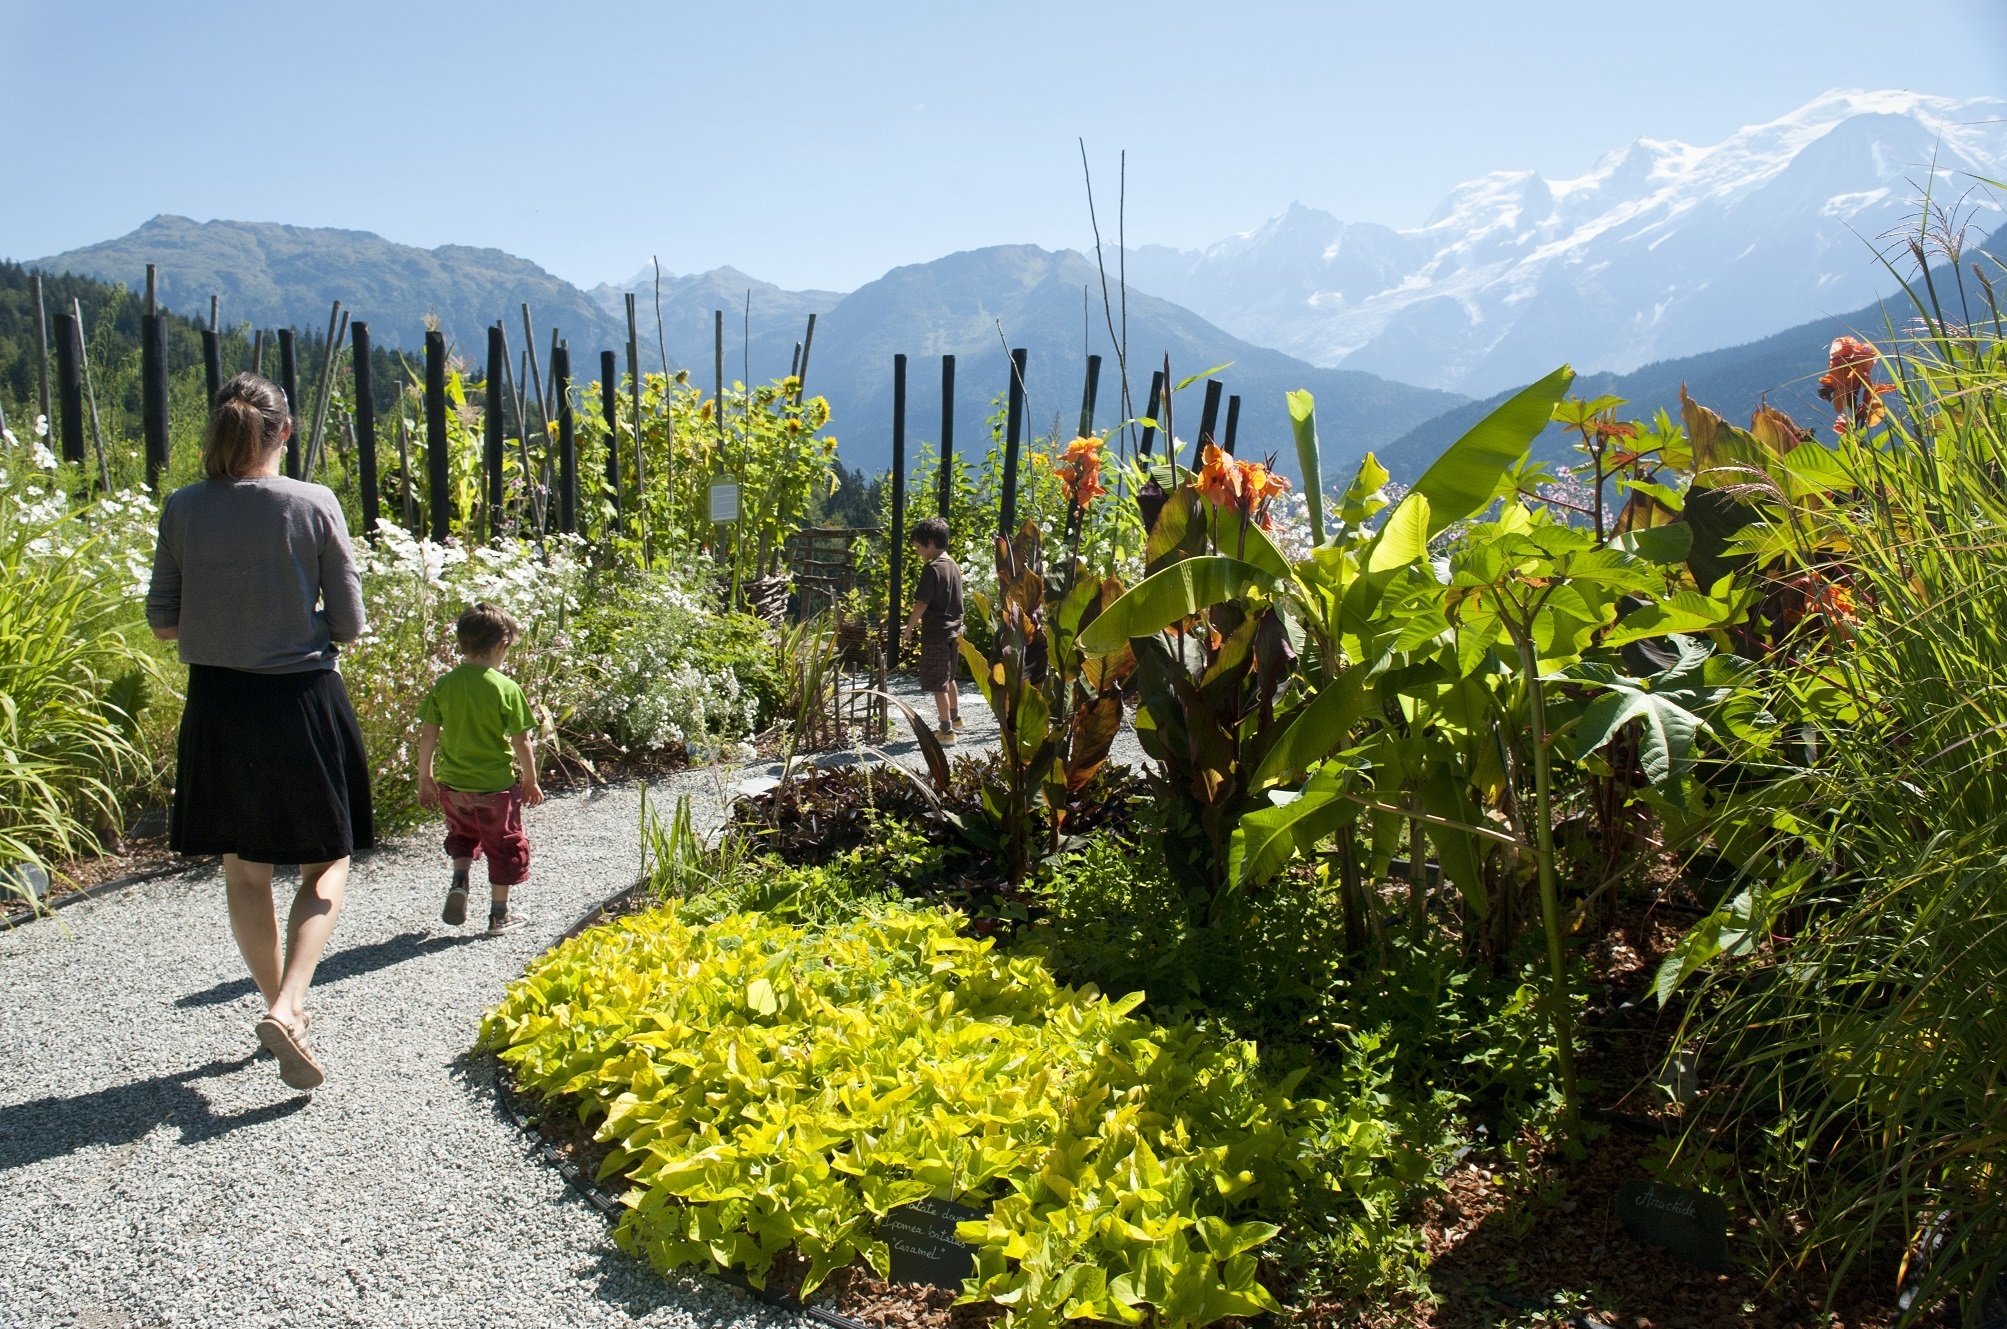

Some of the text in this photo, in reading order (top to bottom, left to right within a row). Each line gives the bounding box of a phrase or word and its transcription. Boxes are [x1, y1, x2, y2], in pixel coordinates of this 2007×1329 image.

[905, 1199, 938, 1216] atate
[1635, 1187, 1698, 1219] Arachide
[882, 1213, 926, 1235] Ipomea
